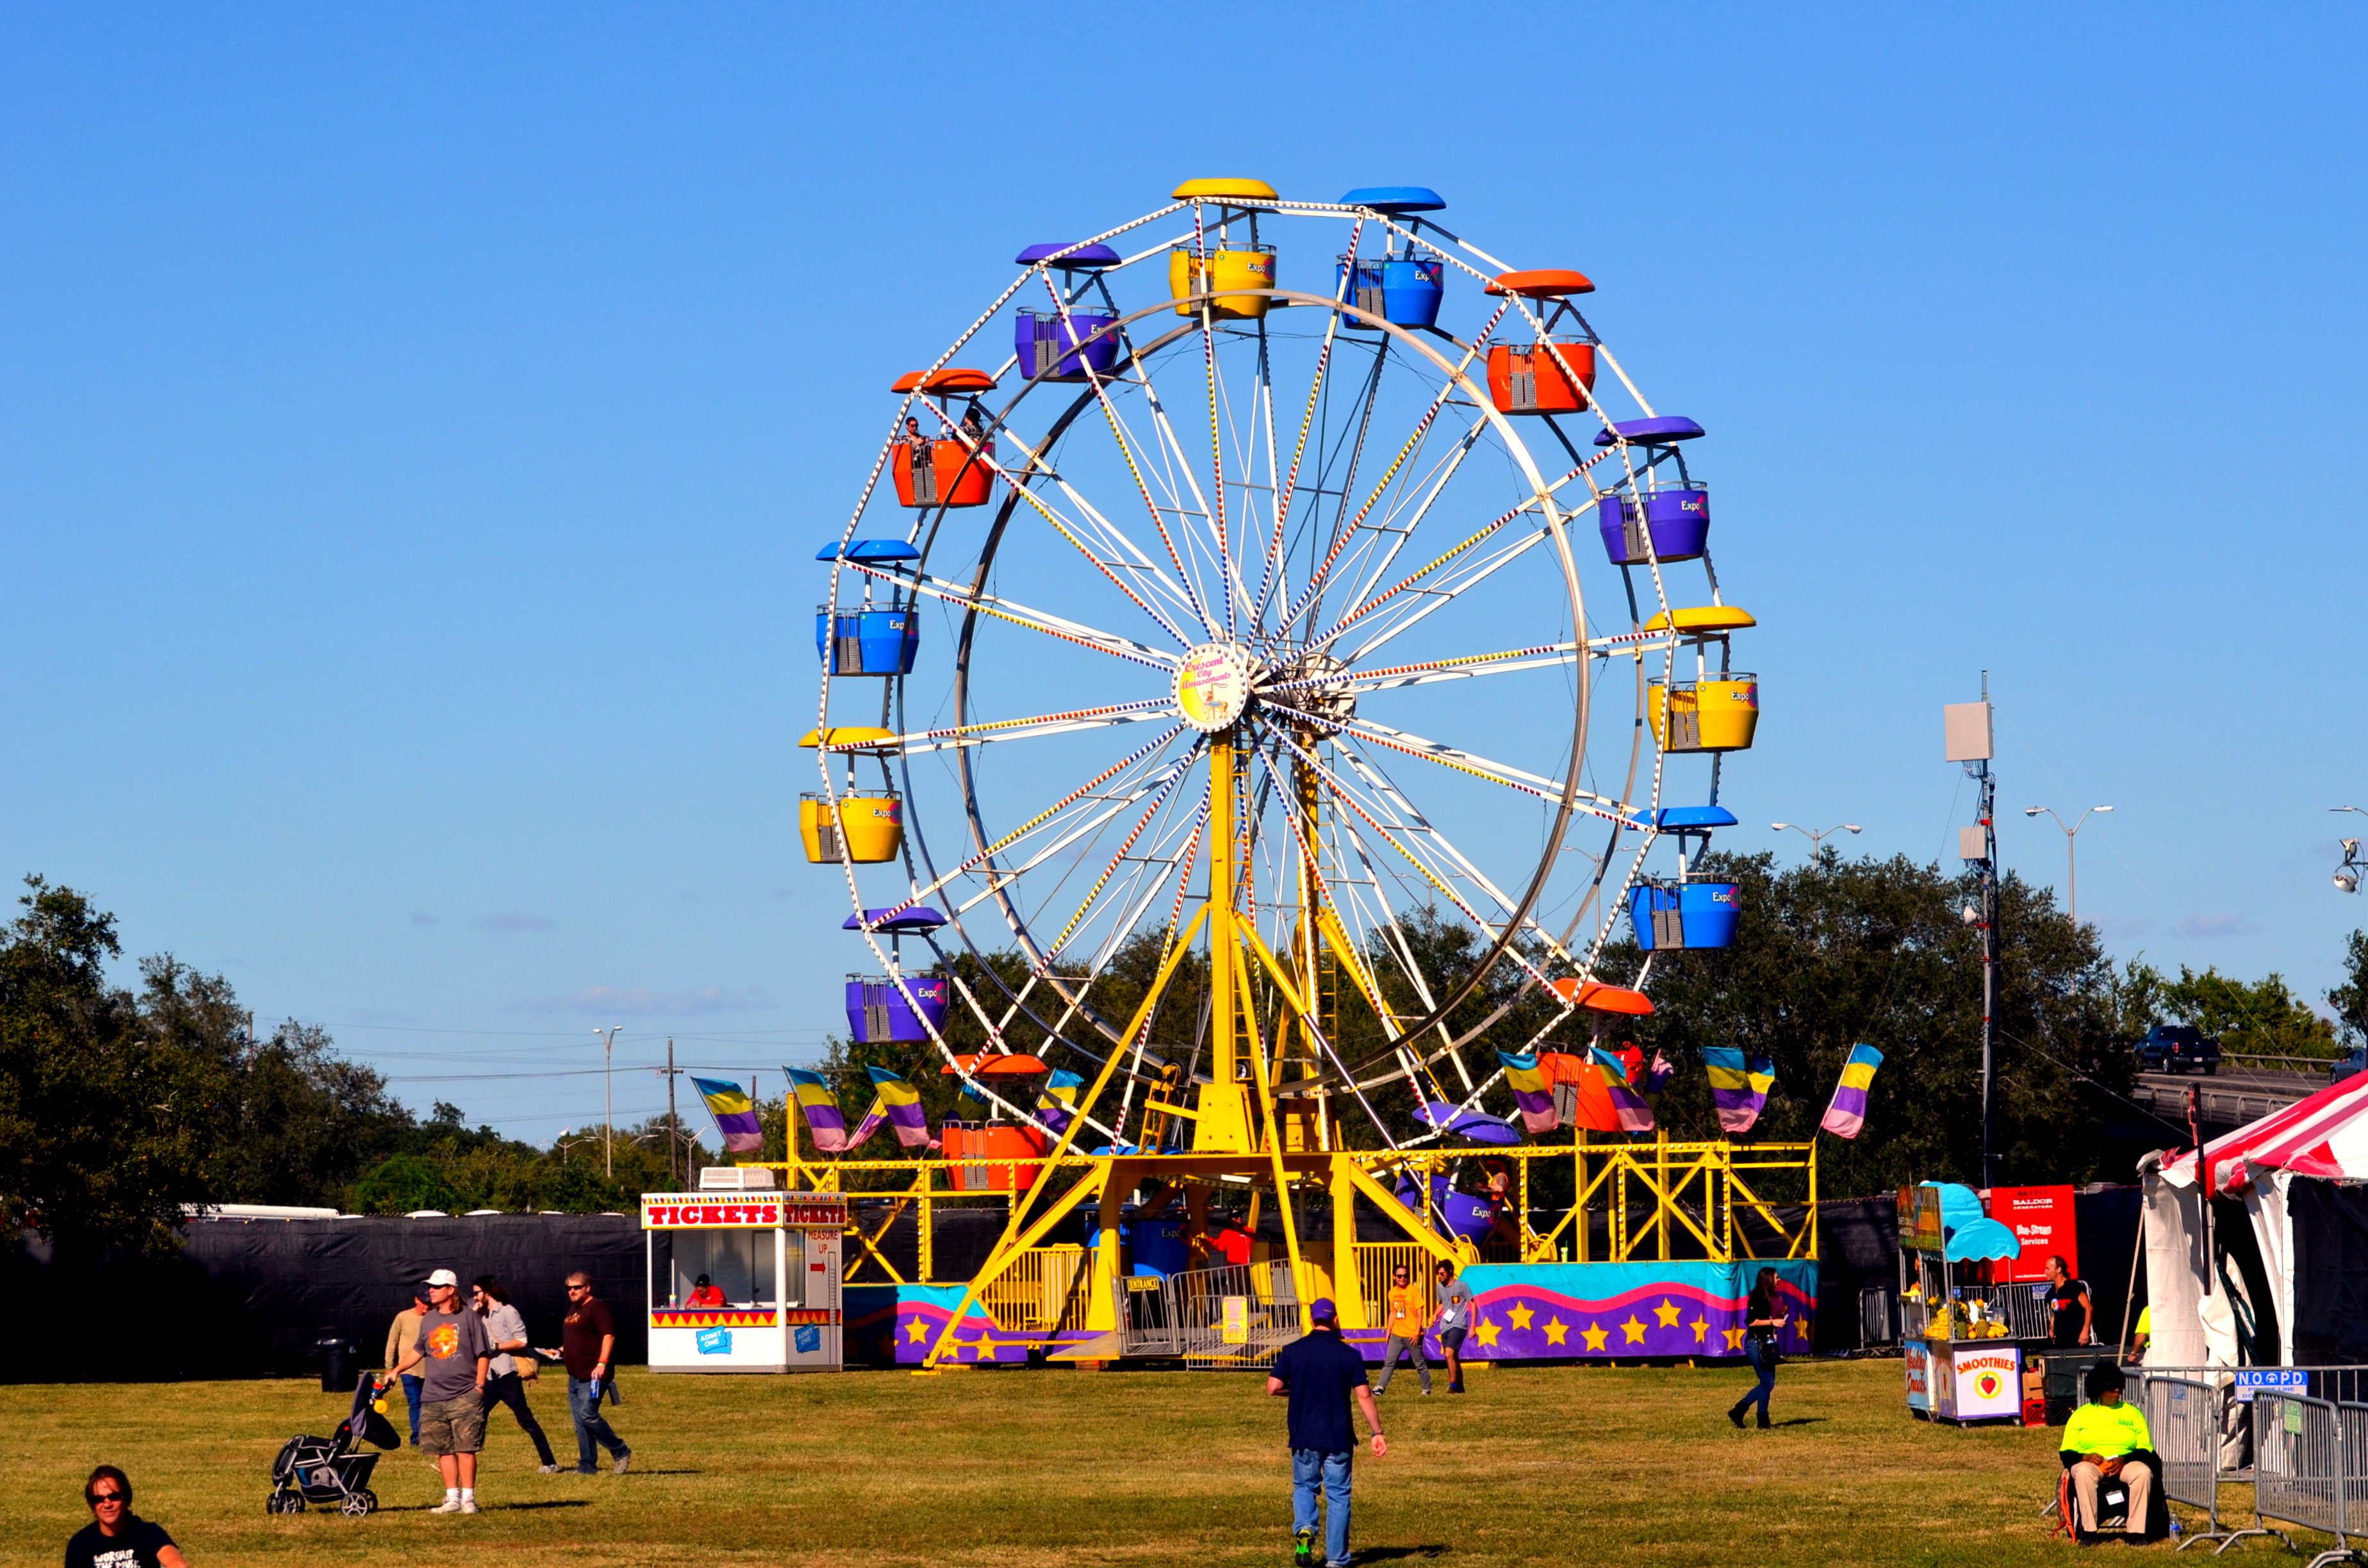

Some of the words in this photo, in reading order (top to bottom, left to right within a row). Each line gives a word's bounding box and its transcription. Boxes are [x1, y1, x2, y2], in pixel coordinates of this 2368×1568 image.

[1247, 261, 1265, 274] Expo
[1415, 270, 1433, 282] Expo
[1681, 500, 1700, 512] Expo
[890, 620, 905, 631] Exp
[1185, 656, 1223, 672] Crescent
[1197, 669, 1212, 678] City
[1182, 671, 1231, 689] Amusements
[1731, 690, 1749, 702] Expo
[873, 808, 891, 819] Expo
[1713, 892, 1731, 903] Expo
[919, 988, 937, 999] Expo
[648, 1205, 778, 1225] TICKETS
[784, 1204, 845, 1223] TICKETS
[1472, 1207, 1492, 1220] Expo
[808, 1230, 838, 1240] MEASURE
[1162, 1229, 1180, 1239] Expo
[2016, 1224, 2052, 1236] Blue-Stream
[819, 1244, 828, 1254] UP
[1130, 1279, 1156, 1289] ENTRANCE
[701, 1330, 721, 1342] ADMIT
[704, 1337, 719, 1348] ONE
[1957, 1357, 2015, 1375] SMOOTHIES
[2239, 1373, 2265, 1385] N.O.
[2281, 1373, 2305, 1385] P.D.
[94, 1549, 134, 1562] WORSHIP
